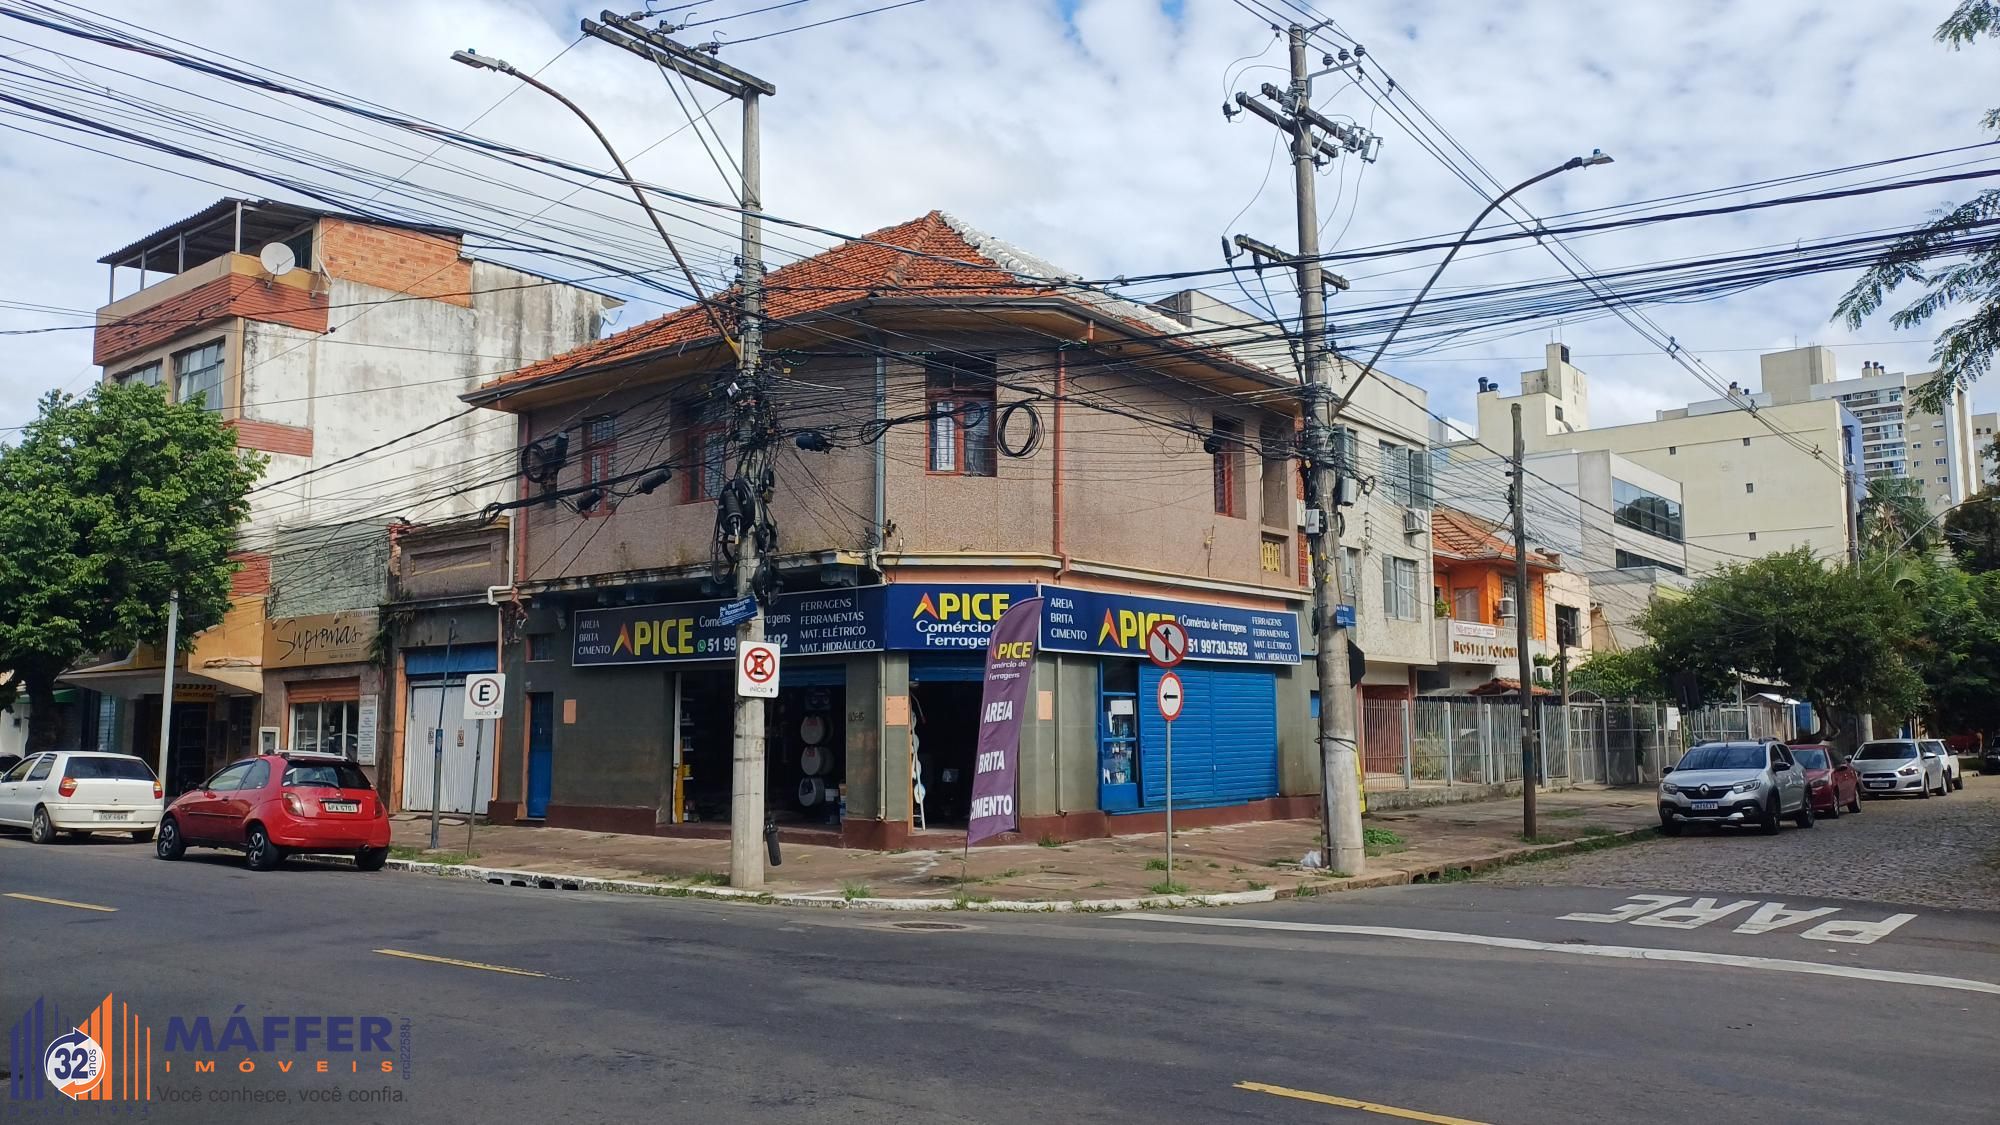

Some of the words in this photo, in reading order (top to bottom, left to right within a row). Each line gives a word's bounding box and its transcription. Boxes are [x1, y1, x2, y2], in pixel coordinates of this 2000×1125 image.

[800, 598, 852, 611] FERRAGENS
[1050, 598, 1074, 610] AREIA
[578, 619, 600, 630] AREIA
[800, 611, 864, 625] FERRAMENTAS
[1050, 612, 1074, 625] BRITA
[1182, 614, 1210, 629] Comércio
[1211, 618, 1219, 630] de
[1219, 620, 1247, 635] Ferragens
[1251, 616, 1282, 627] FERRAGENS
[800, 629, 821, 639] MAT.
[822, 624, 866, 638] ELÉTRICO
[916, 619, 991, 633] Comércio
[277, 619, 363, 662] Supremas
[578, 632, 599, 642] BRITA
[612, 617, 694, 656] APICE
[1050, 627, 1088, 640] CIMENTO
[1252, 629, 1290, 639] FERRAMENTAS
[707, 638, 720, 652] 51
[800, 643, 821, 653] MAT.
[822, 639, 876, 652] HIDRÁULICO
[926, 633, 991, 649] Ferrage
[1188, 639, 1199, 653] 51
[1201, 640, 1249, 656] 99730.5592
[1267, 639, 1292, 650] ELÉTRICO
[578, 645, 611, 655] CIMENTO
[991, 660, 1017, 670] omércio
[479, 684, 490, 701] E
[984, 700, 1013, 723] AREIA
[977, 750, 1005, 775] BRITA
[1555, 894, 1918, 944] PARE
